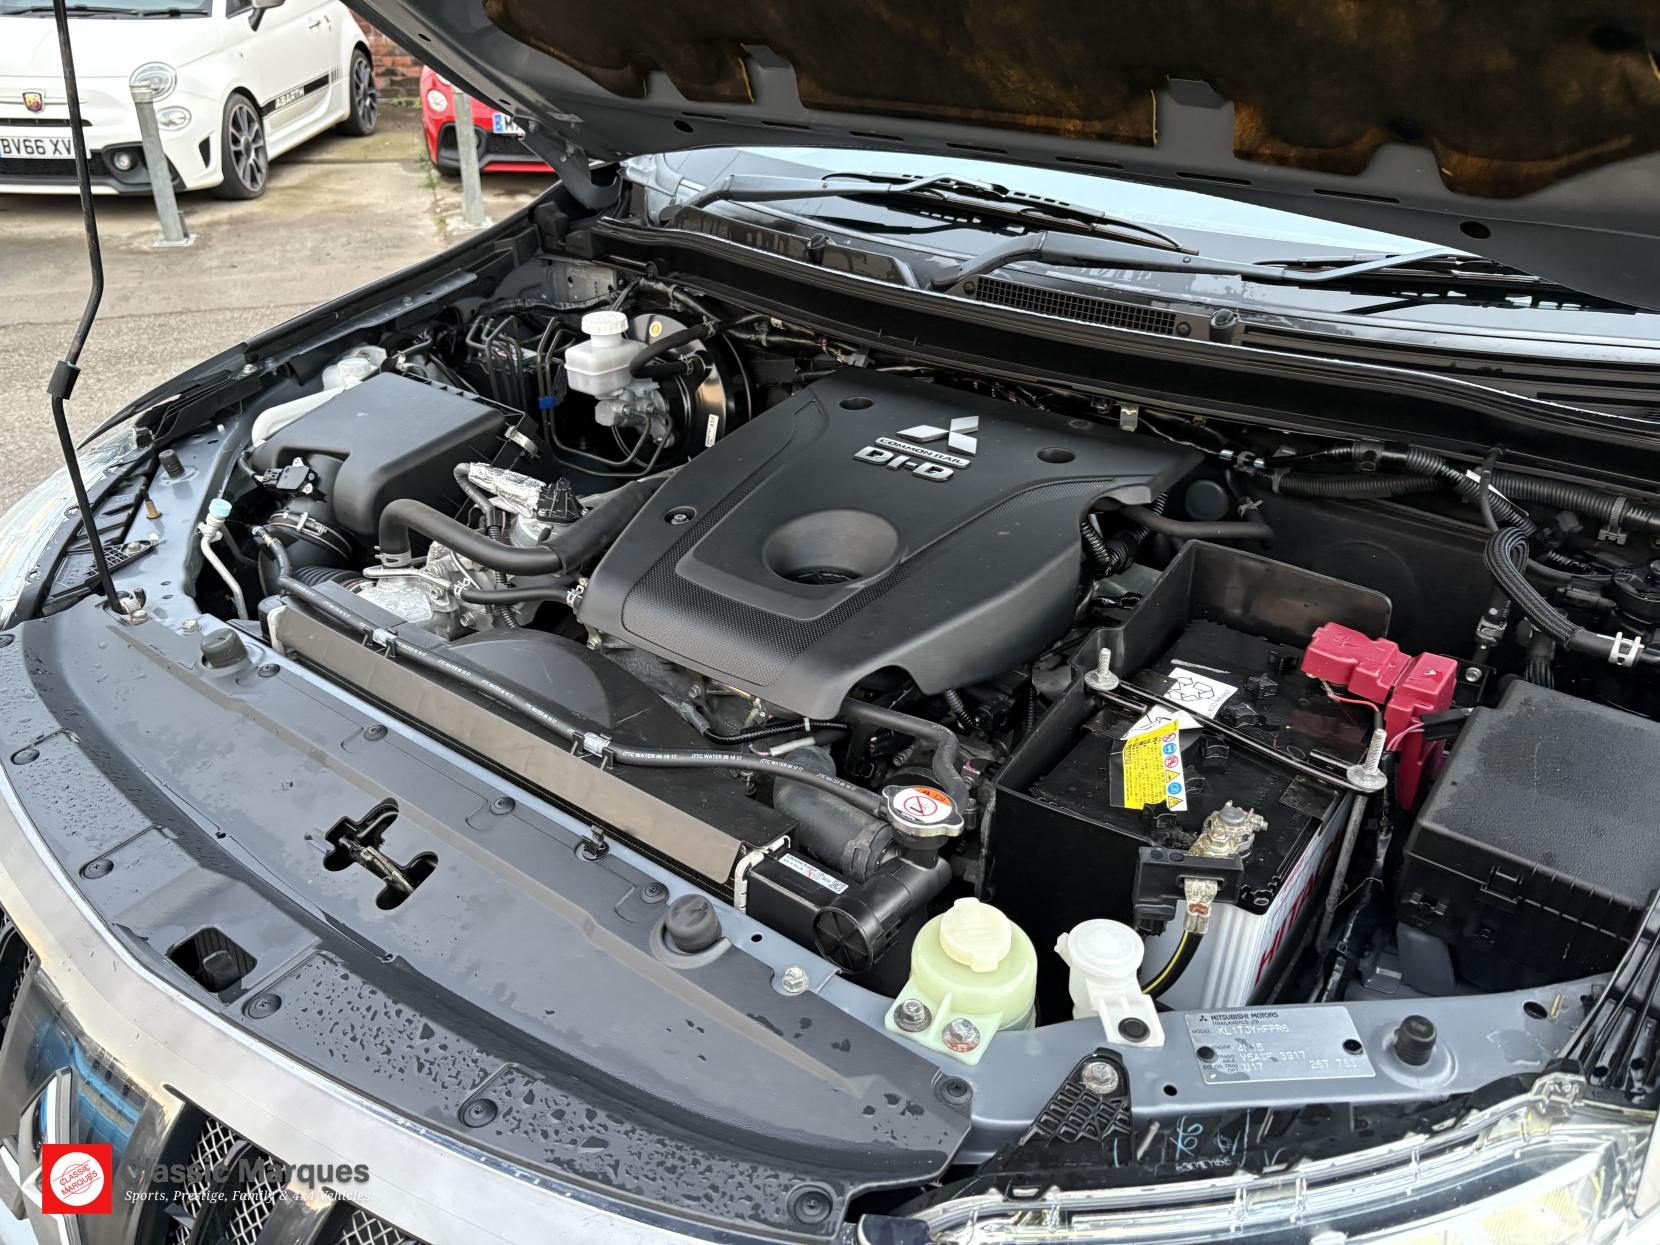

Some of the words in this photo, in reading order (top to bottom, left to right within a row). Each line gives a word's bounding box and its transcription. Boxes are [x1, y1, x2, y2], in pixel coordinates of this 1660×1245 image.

[1, 138, 46, 155] BV66
[49, 138, 72, 156] XV
[880, 438, 933, 456] COMMON
[934, 452, 964, 465] RAIL
[854, 446, 955, 482] DI-D
[1210, 1013, 1250, 1021] MITSUBISHI
[1250, 1011, 1279, 1019] MOTORS
